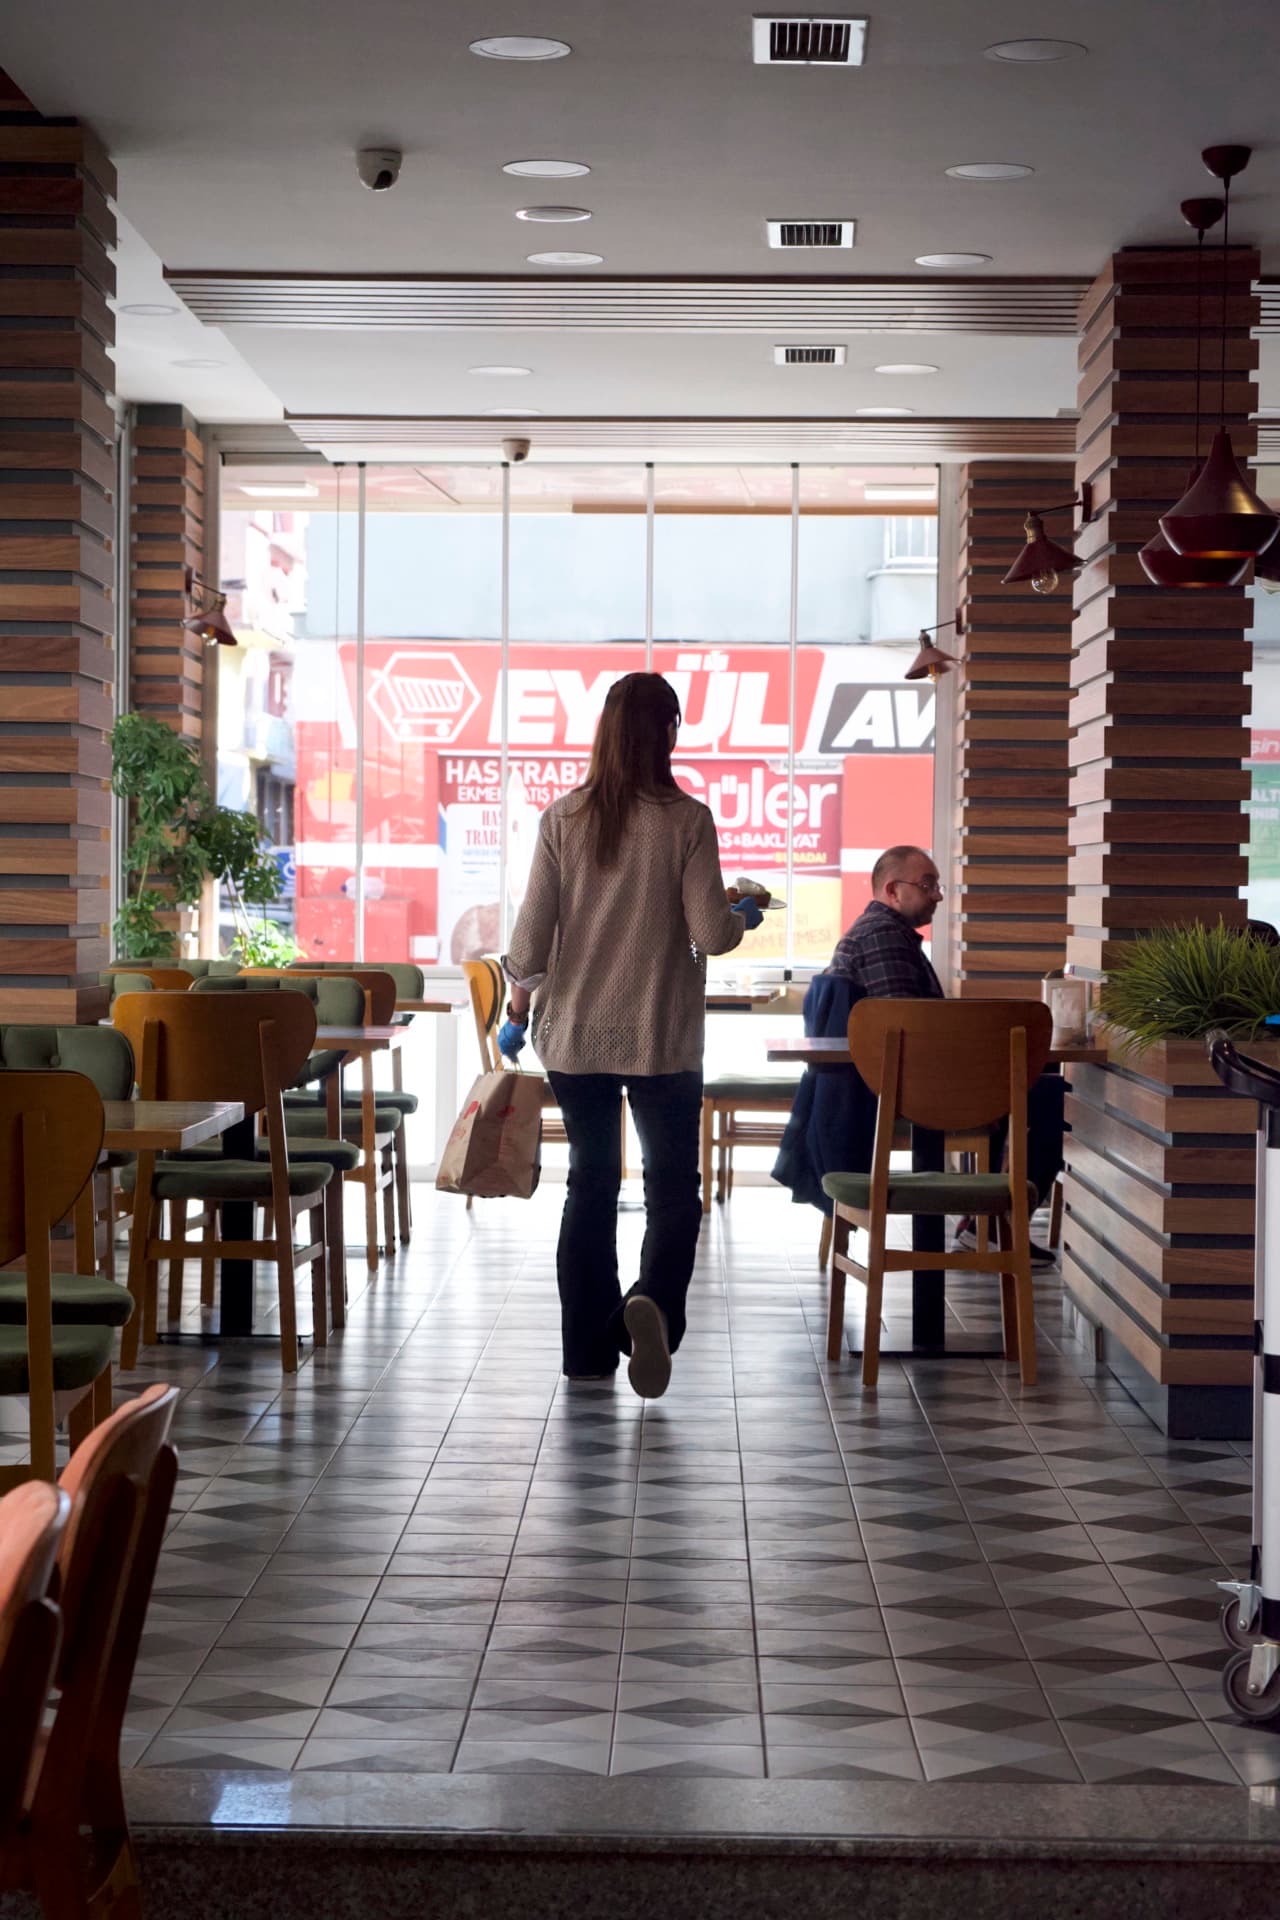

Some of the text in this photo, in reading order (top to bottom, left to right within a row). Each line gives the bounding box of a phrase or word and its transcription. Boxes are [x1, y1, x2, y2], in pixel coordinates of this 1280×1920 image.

[488, 652, 789, 748] EYÜL
[830, 689, 936, 748] AV
[445, 760, 500, 784] HAS
[482, 810, 502, 826] HA
[465, 829, 503, 846] TRAB
